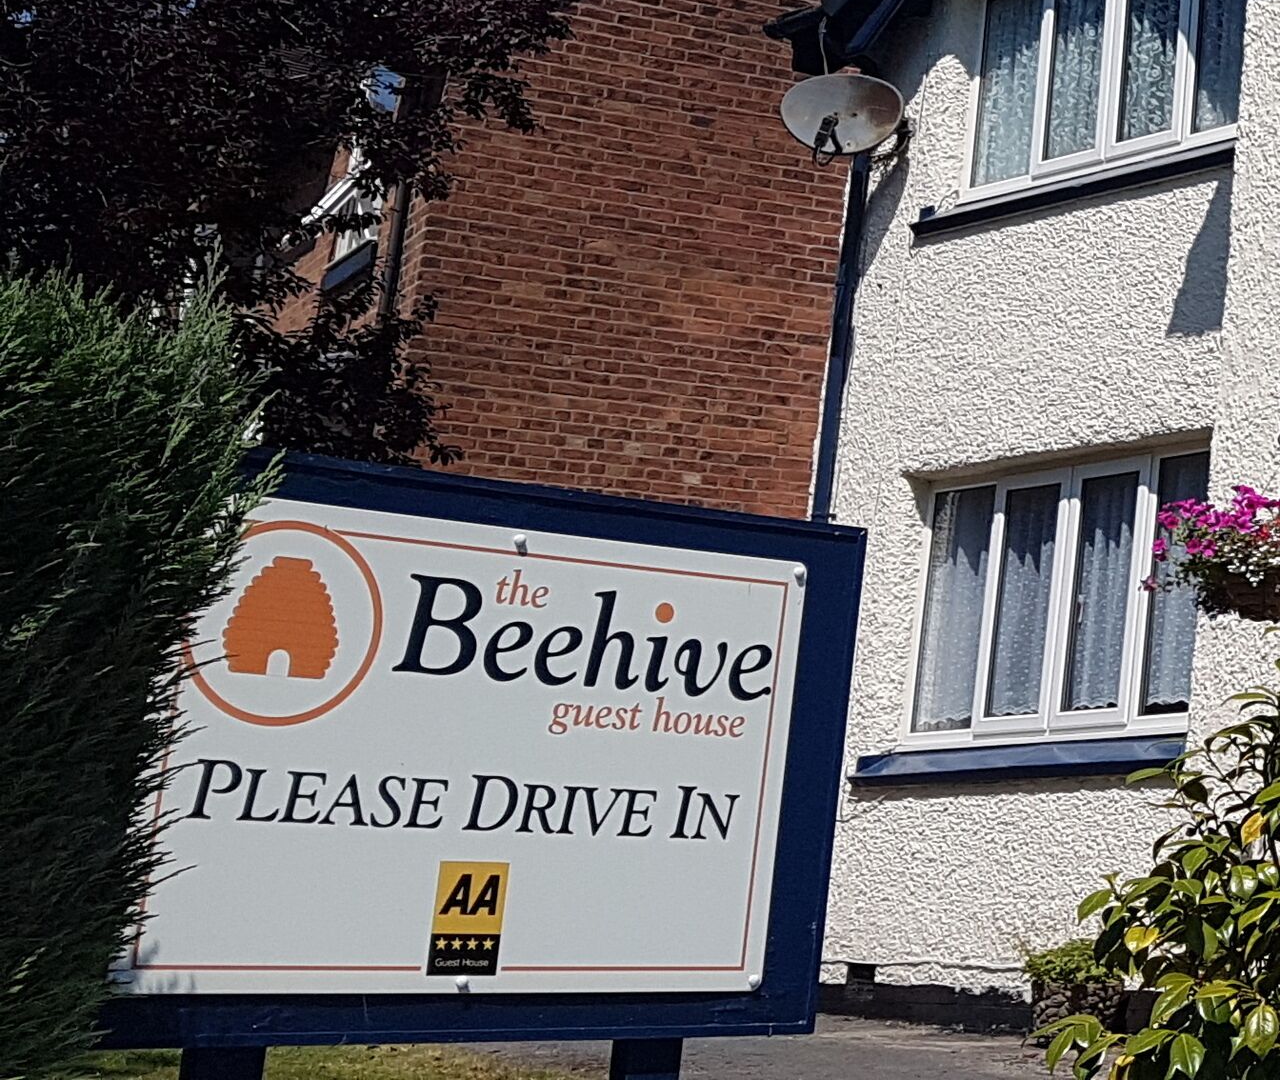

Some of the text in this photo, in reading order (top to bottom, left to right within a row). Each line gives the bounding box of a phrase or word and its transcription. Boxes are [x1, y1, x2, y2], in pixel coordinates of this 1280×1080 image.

[495, 569, 549, 609] the
[392, 573, 773, 701] Beehive
[548, 697, 746, 738] guest house
[184, 759, 740, 840] PLEASE DRIVE IN
[439, 873, 501, 916] AA
[434, 958, 489, 967] Guest House
